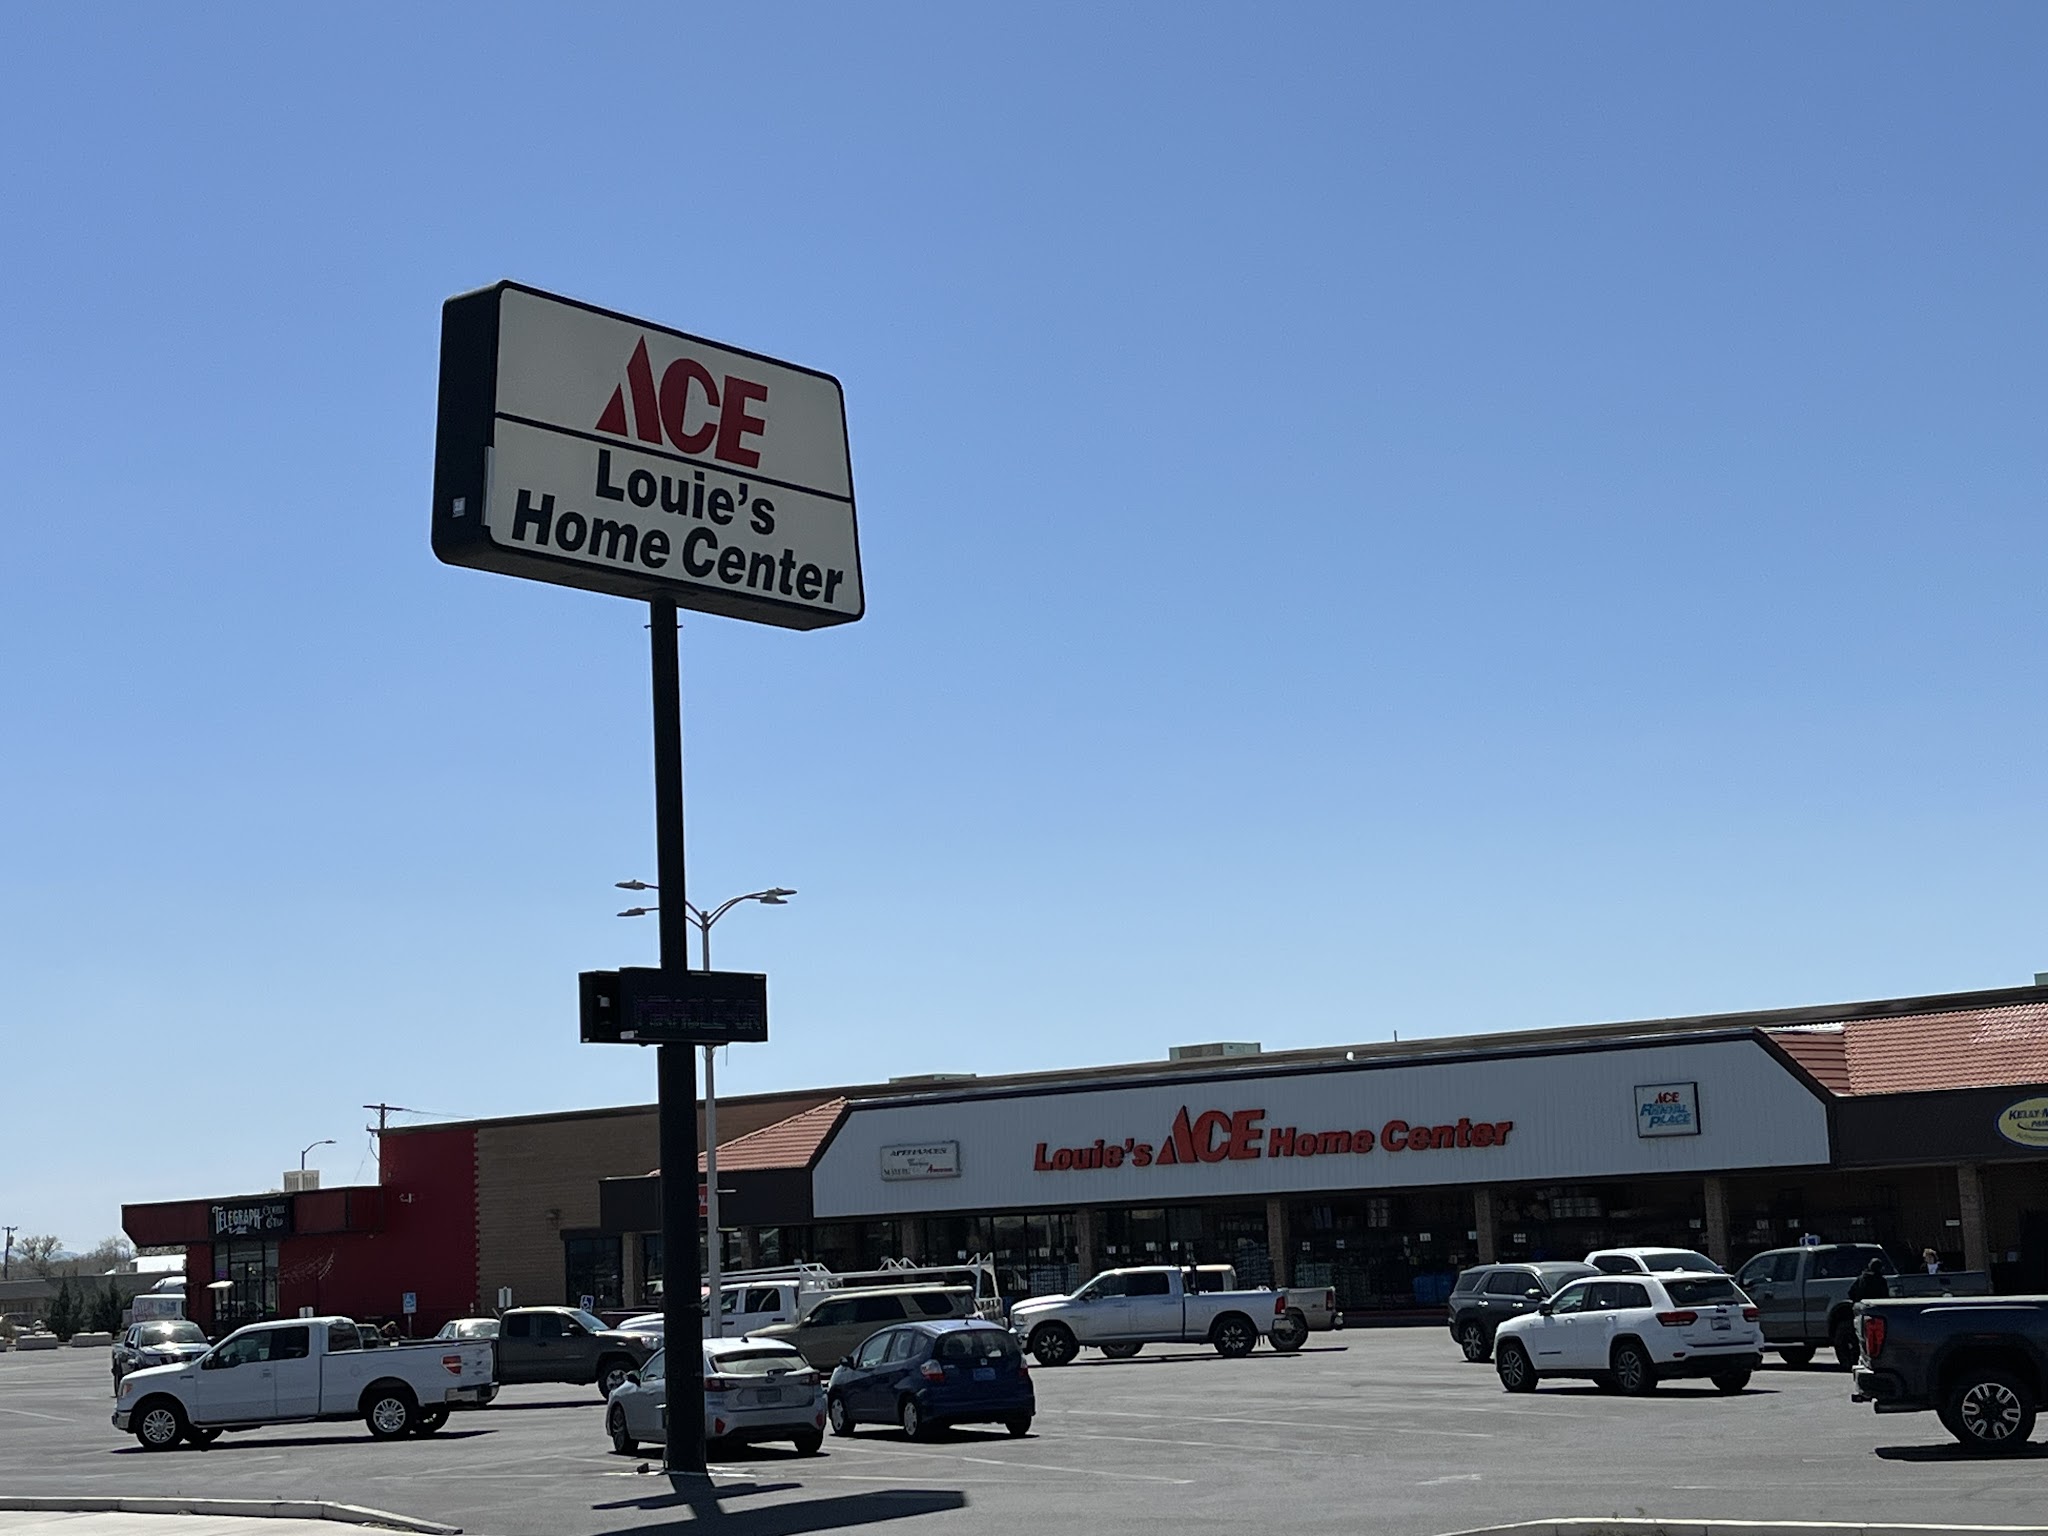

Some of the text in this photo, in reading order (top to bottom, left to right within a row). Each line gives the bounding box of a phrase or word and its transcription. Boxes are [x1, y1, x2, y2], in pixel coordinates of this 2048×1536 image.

[594, 334, 768, 469] ACE
[595, 449, 775, 535] Louie's
[512, 489, 843, 603] Home Center
[1649, 1113, 1691, 1128] PLACE
[1655, 1092, 1679, 1104] ACE
[1033, 1105, 1513, 1171] Louie's ACE Home Center
